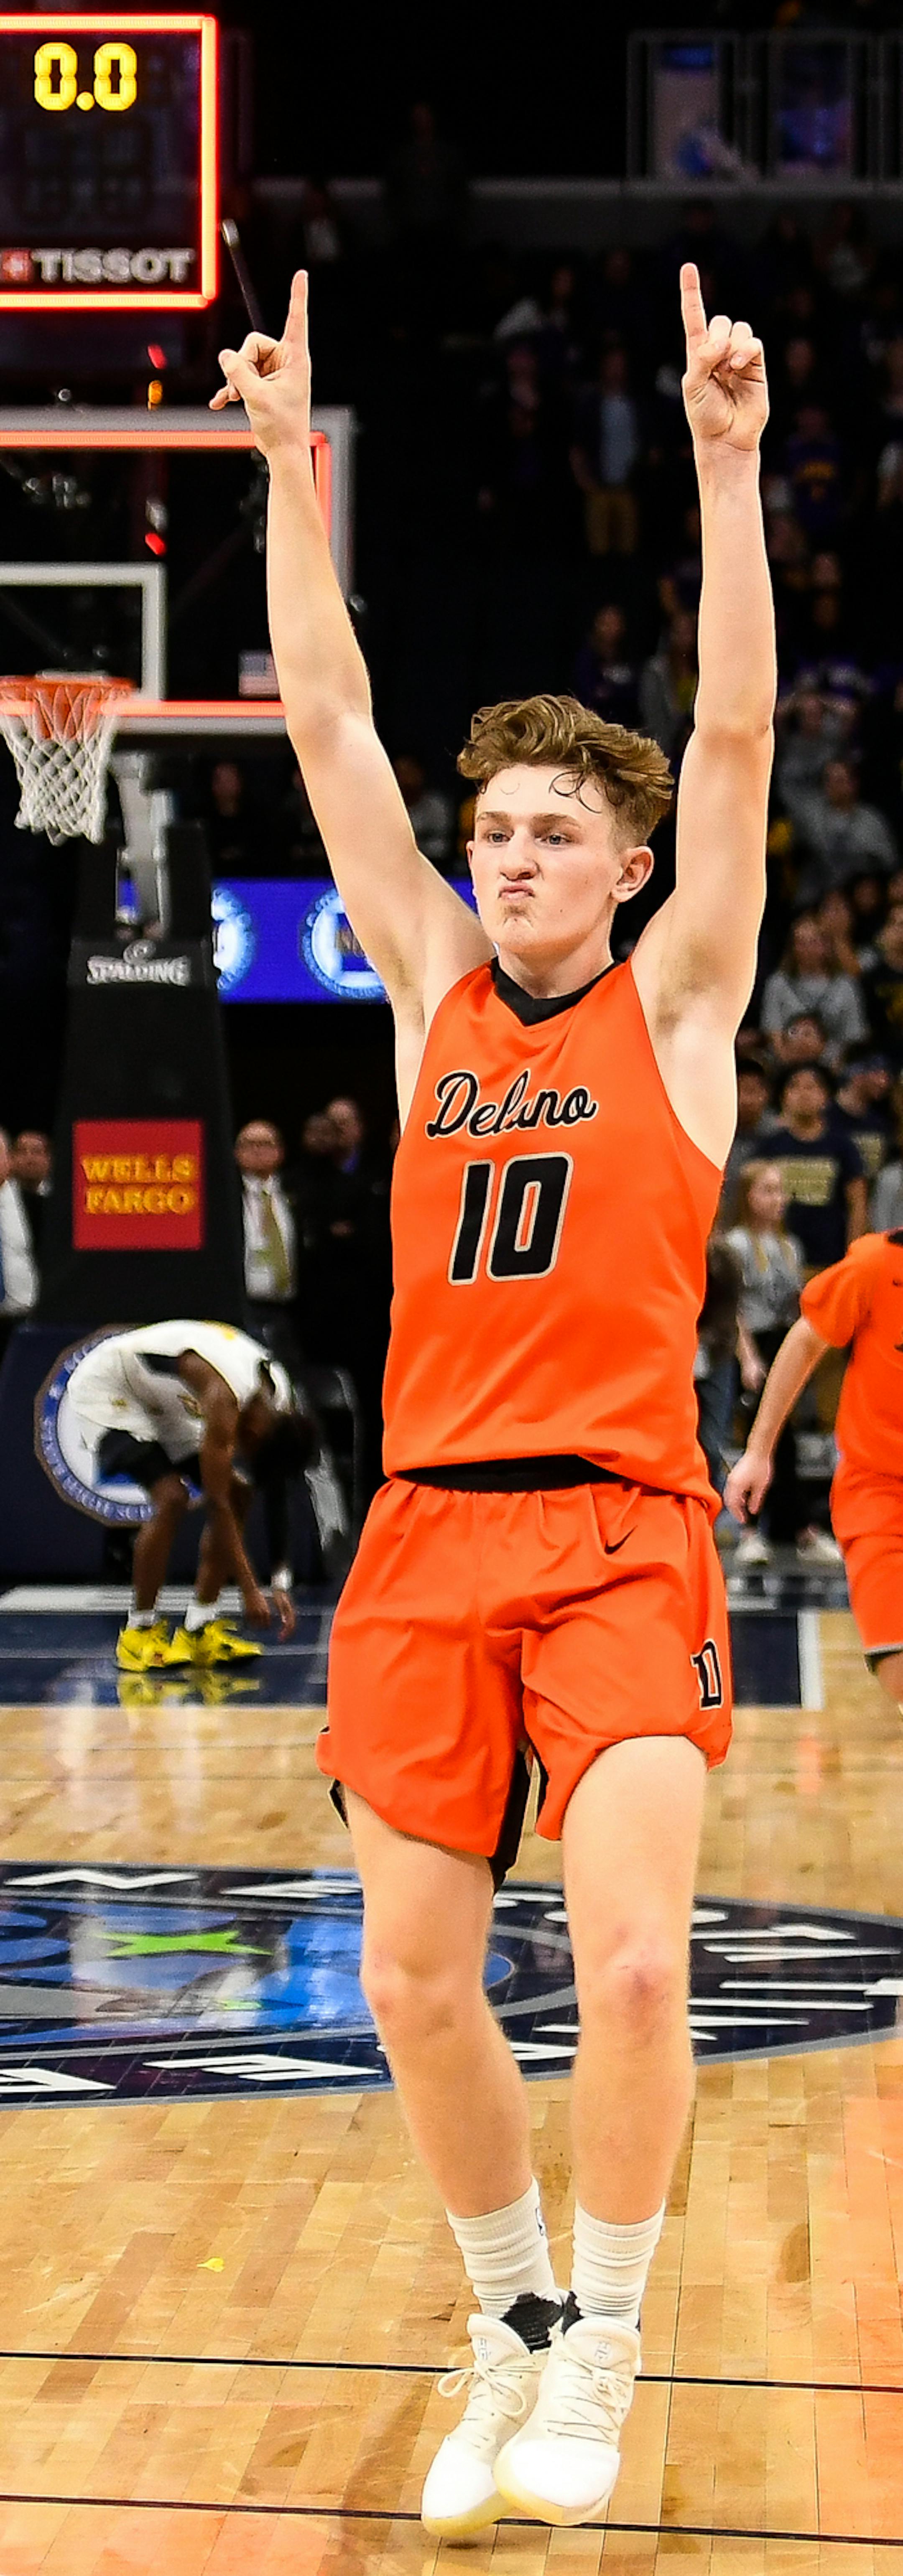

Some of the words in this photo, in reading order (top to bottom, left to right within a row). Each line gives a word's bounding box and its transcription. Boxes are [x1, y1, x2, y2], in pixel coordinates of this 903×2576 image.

[34, 42, 137, 111] 0.0
[33, 248, 195, 283] TISSOT
[87, 955, 190, 986] SPALDING
[82, 1154, 196, 1182] WELLS
[85, 1184, 196, 1215] FARGO
[448, 1151, 574, 1286] 10
